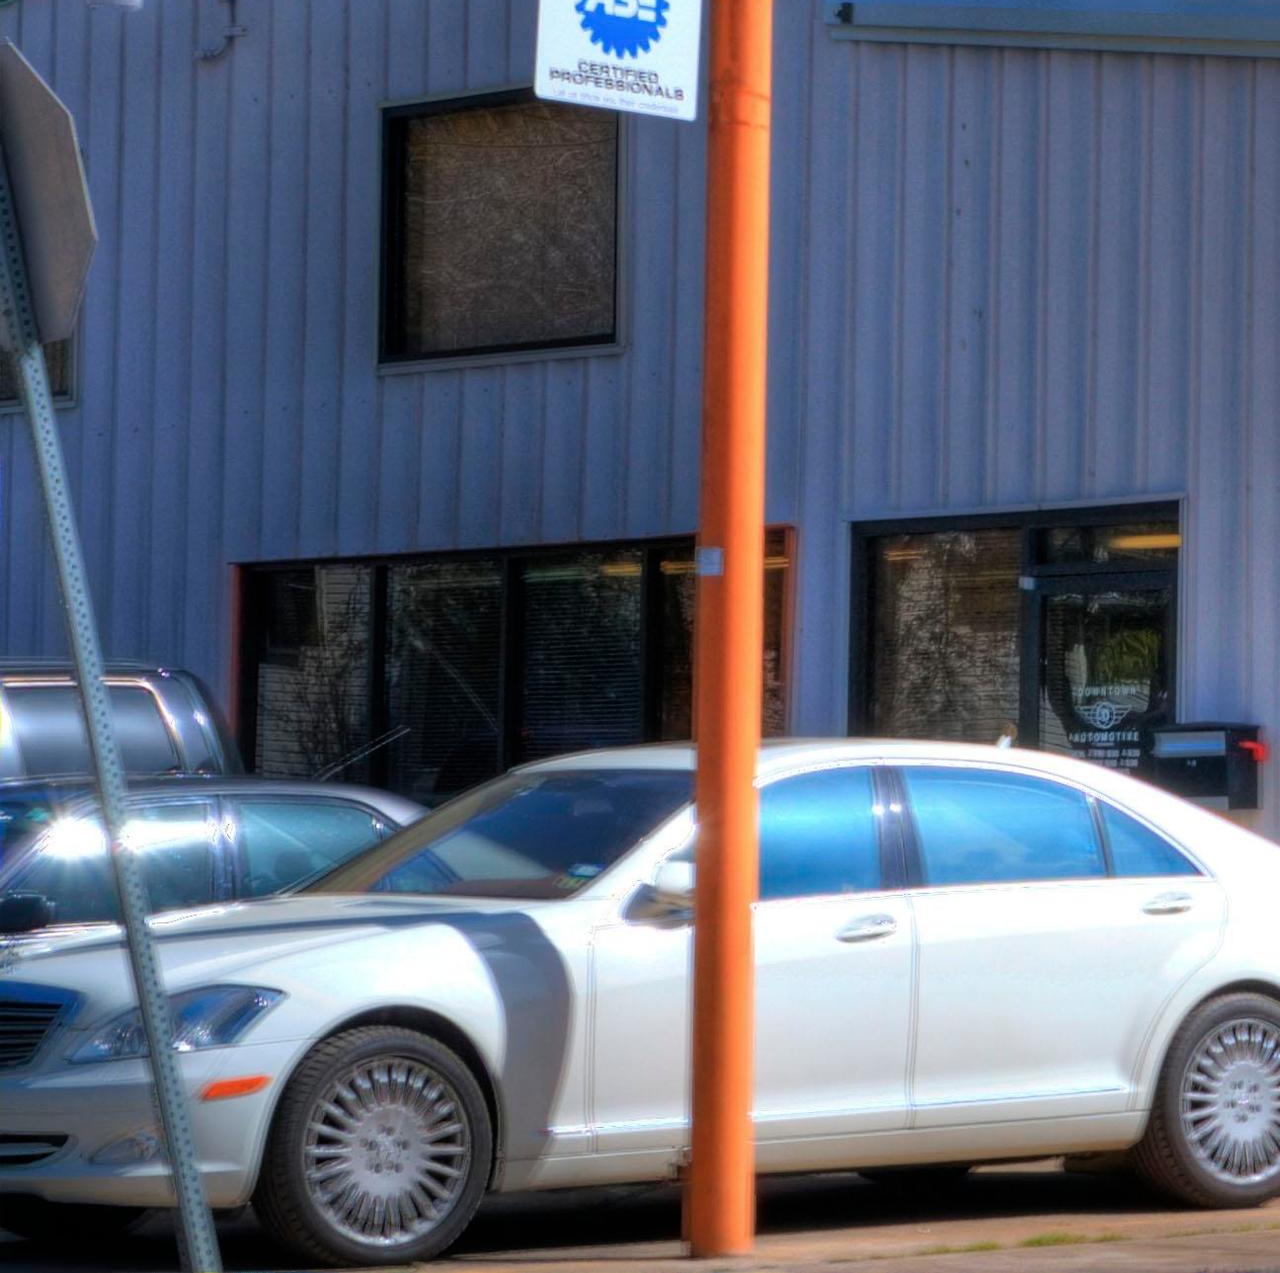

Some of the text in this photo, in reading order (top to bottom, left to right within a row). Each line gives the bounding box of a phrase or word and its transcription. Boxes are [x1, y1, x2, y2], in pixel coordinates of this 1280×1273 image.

[577, 59, 660, 85] CERTIFIED
[549, 67, 685, 101] PROFESSIONALS
[1077, 685, 1137, 698] DOWNTOWN
[1070, 730, 1140, 744] AUTOMOTIVE
